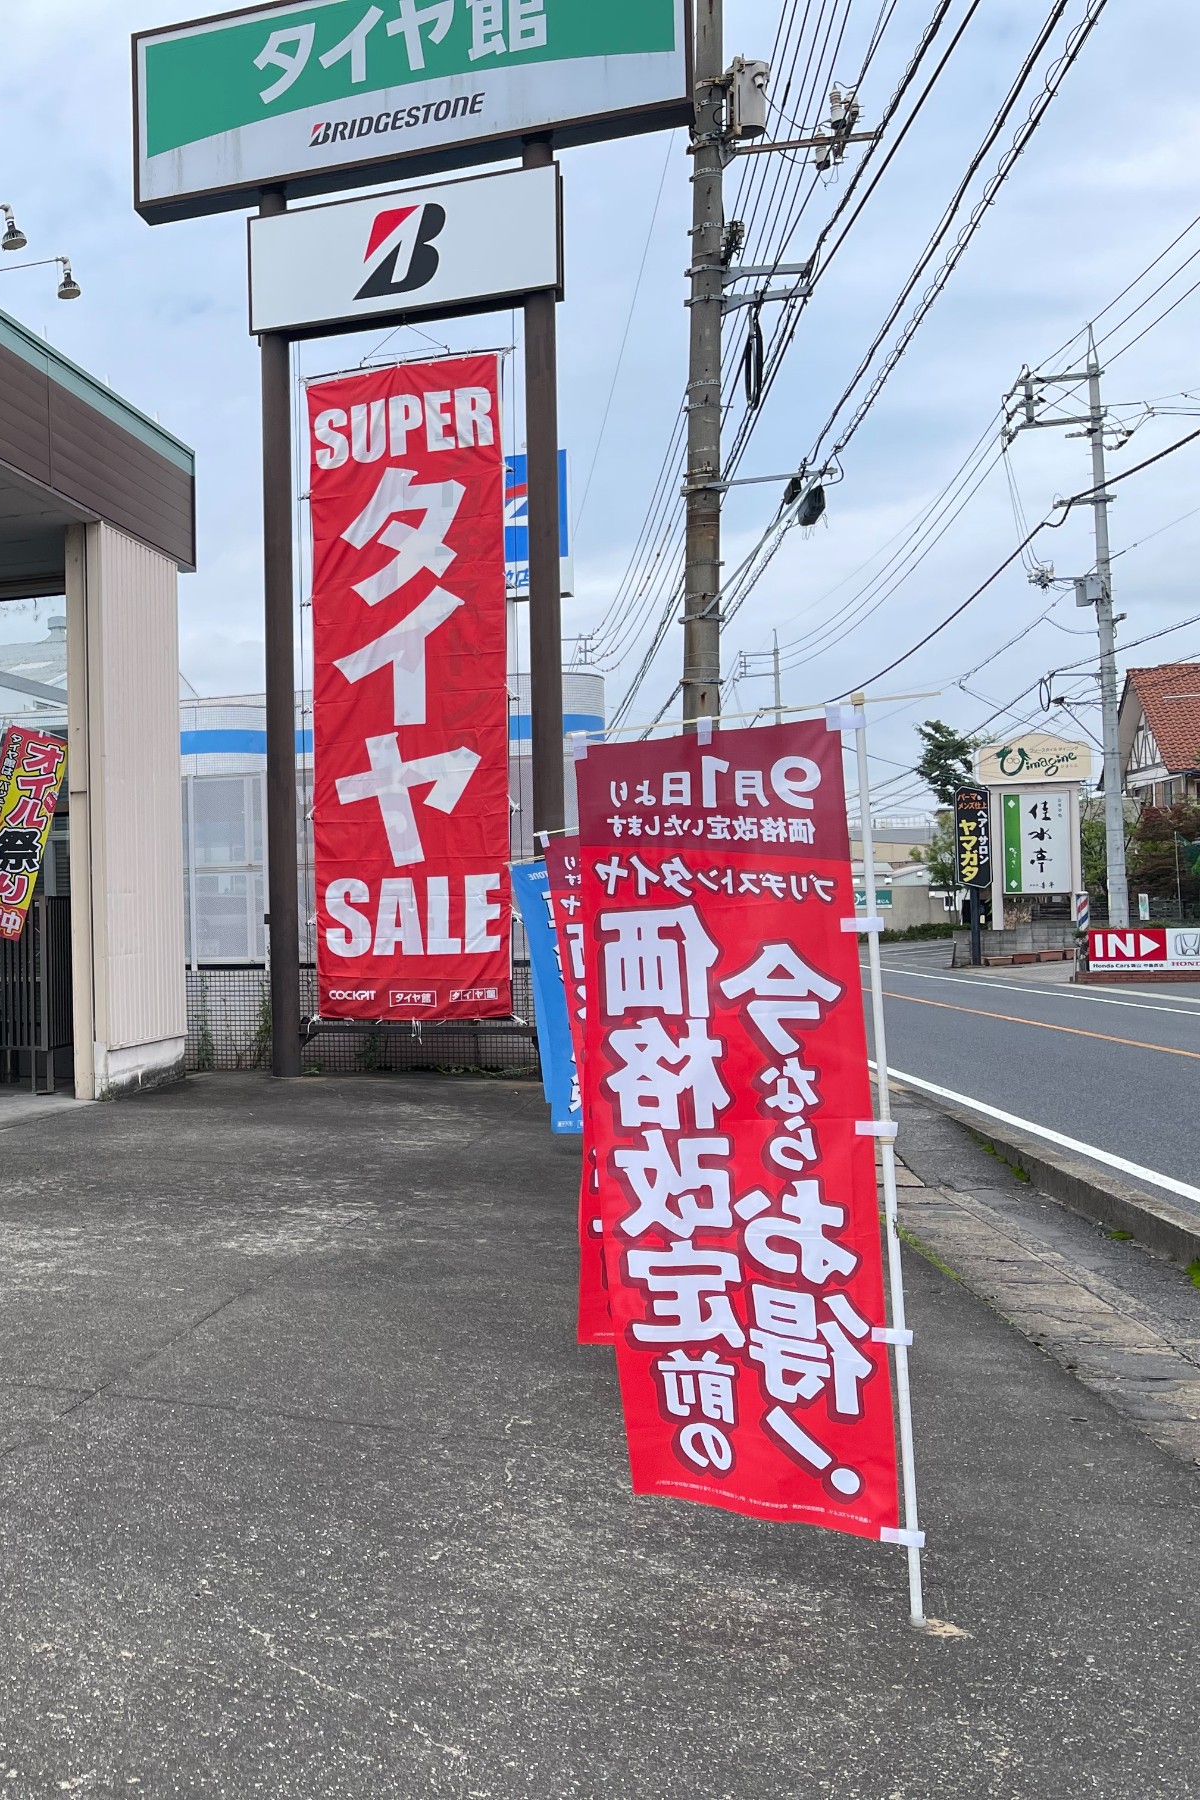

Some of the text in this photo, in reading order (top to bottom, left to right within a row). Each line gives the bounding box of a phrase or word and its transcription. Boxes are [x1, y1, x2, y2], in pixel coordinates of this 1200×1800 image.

[253, 0, 547, 104] タイヤ館
[309, 92, 485, 147] BRIDGESTONE
[314, 386, 494, 470] SUPER
[333, 466, 482, 868] タイヤ
[959, 820, 979, 882] ヤマガタ
[977, 810, 989, 865] ヘアーサロン
[325, 873, 503, 958] SALE
[1095, 933, 1135, 957] IN
[329, 990, 376, 1000] COCKPIT
[395, 993, 432, 1003] タイヤ館
